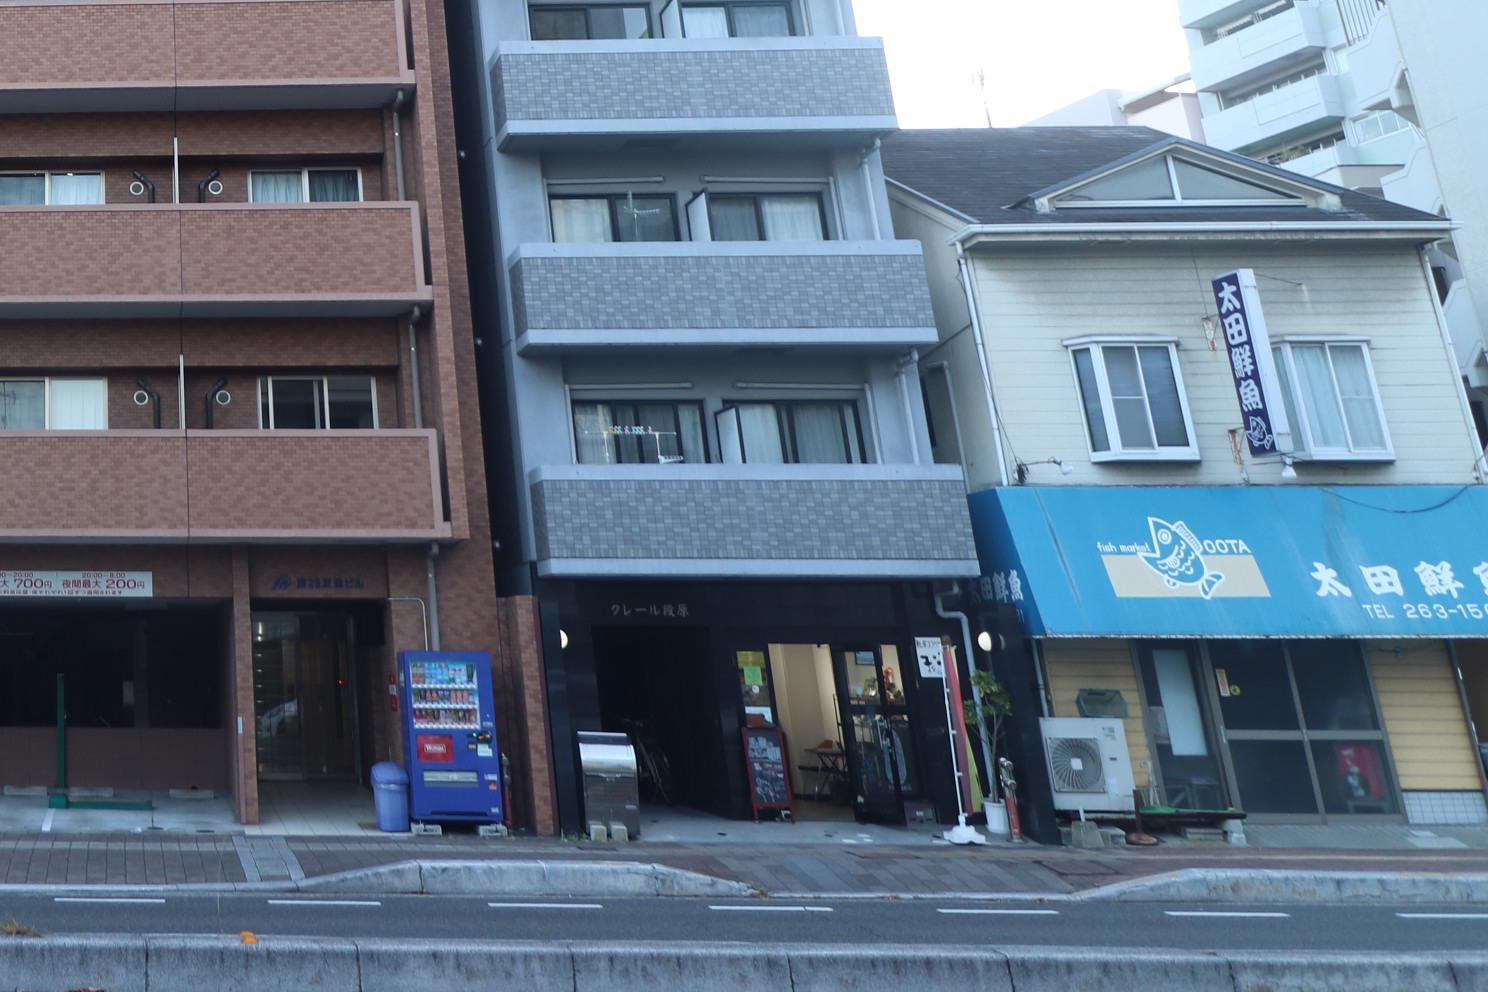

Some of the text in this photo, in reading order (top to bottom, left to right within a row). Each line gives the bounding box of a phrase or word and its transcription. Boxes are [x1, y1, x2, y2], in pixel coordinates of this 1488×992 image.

[1218, 281, 1263, 411] 太田鮮魚
[1203, 539, 1252, 554] OOTA
[14, 578, 52, 589] 700円
[62, 579, 145, 589] 夜間最大 200円
[1361, 604, 1395, 619] TEL
